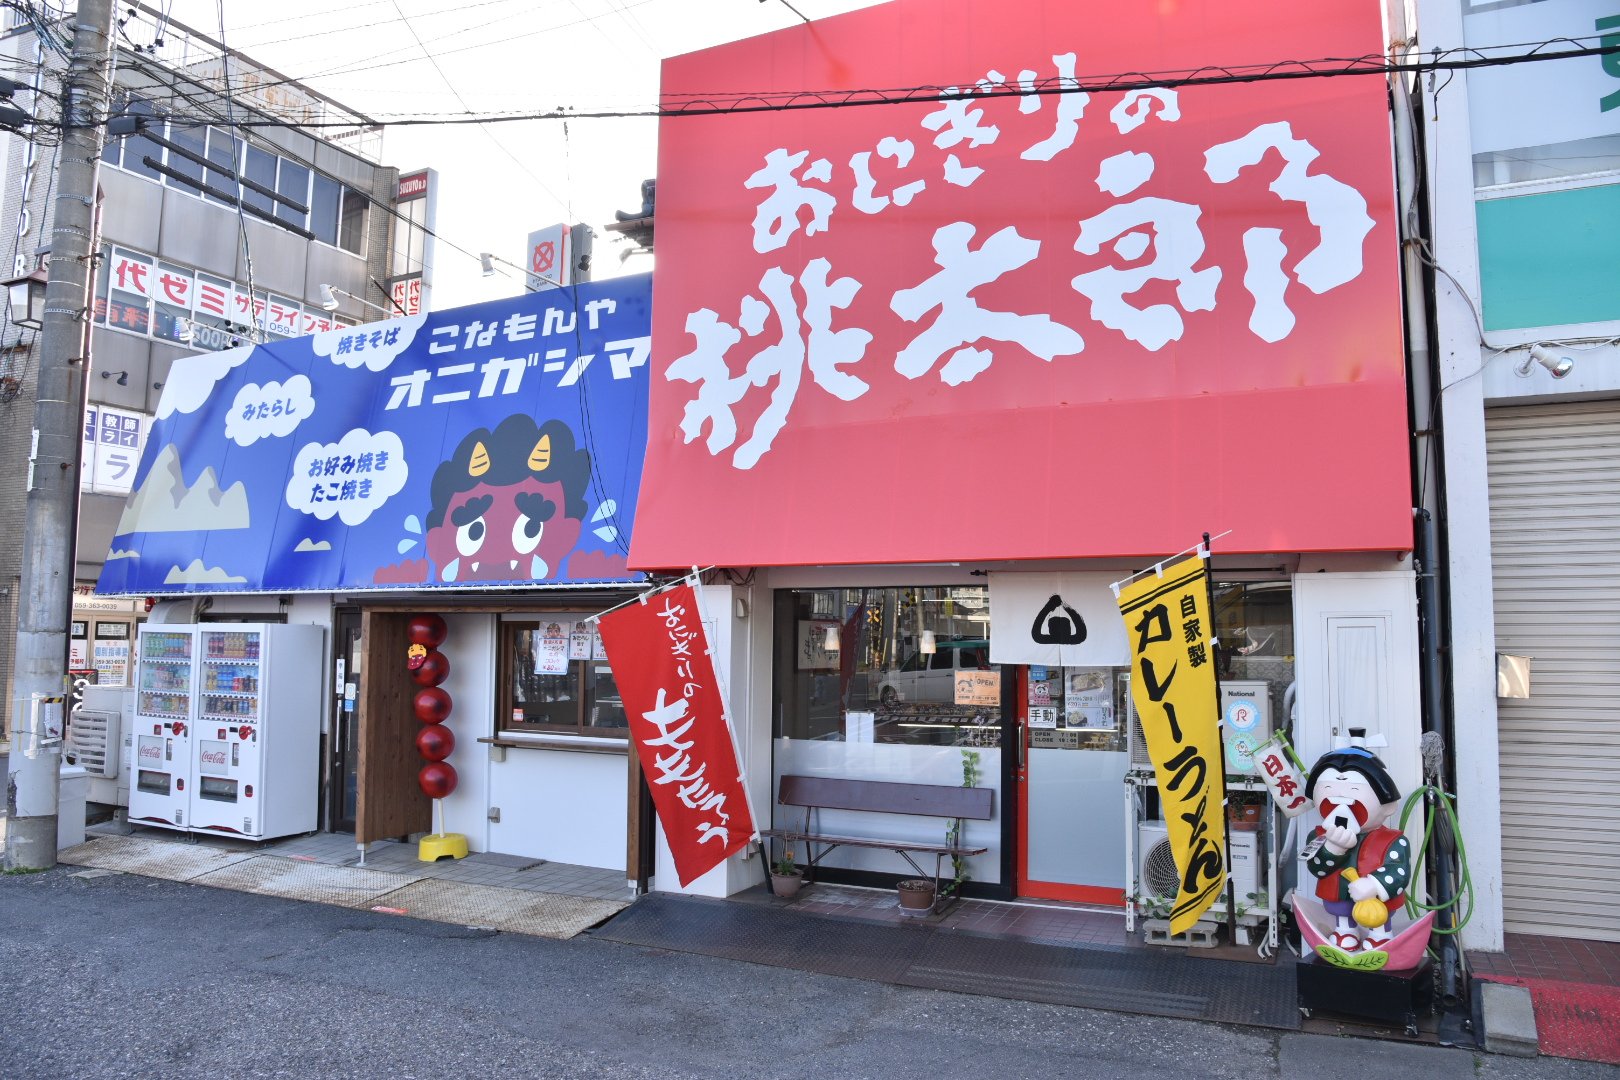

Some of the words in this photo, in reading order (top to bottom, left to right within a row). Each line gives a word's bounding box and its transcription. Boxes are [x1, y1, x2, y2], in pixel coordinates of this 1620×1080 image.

[744, 52, 1181, 253] おにぎりの
[116, 259, 226, 315] 代ゼミ
[665, 121, 1376, 470] 桃太郎
[336, 327, 400, 356] 焼きそば
[429, 299, 617, 354] こなもんや
[384, 336, 650, 411] オニガシマ
[242, 398, 296, 421] みたらし
[307, 451, 389, 477] お好み焼き
[310, 478, 372, 502] たこ焼き
[1180, 594, 1207, 668] 自家製
[1031, 709, 1054, 722] 手動
[1262, 754, 1306, 810] 日本一
